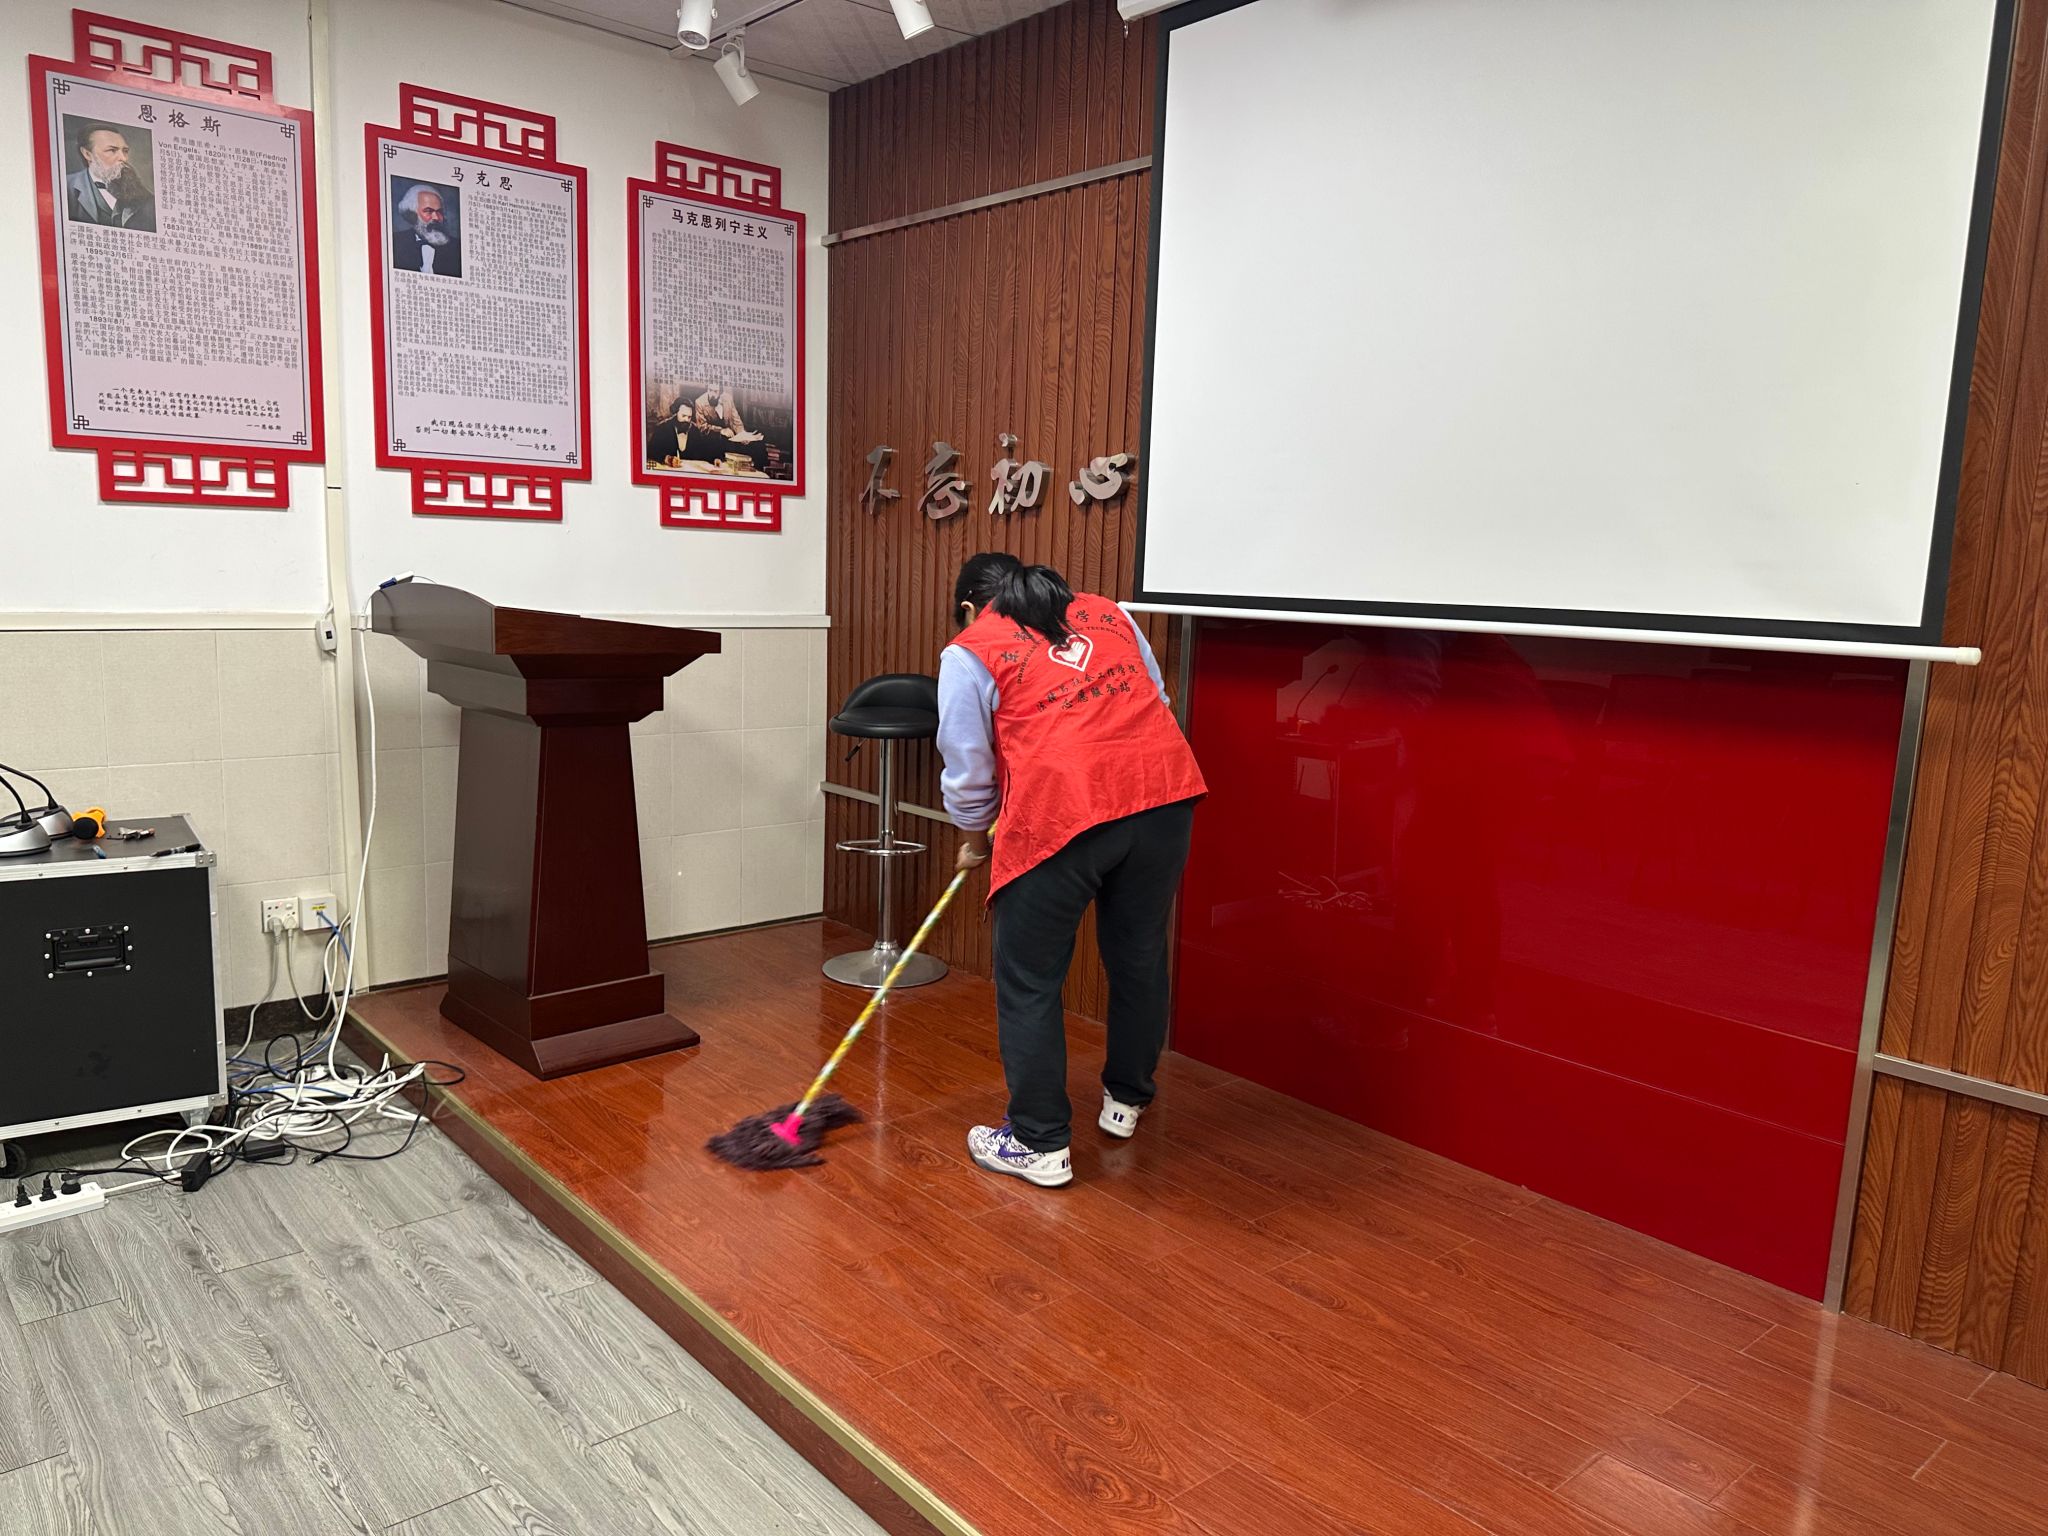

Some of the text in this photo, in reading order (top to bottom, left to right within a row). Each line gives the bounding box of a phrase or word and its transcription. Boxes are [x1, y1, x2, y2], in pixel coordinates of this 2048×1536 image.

[138, 104, 221, 137] 恩格斯
[451, 166, 513, 191] 马克思
[671, 208, 768, 240] 马克思列宁主义
[858, 432, 1135, 520] 不忘初心
